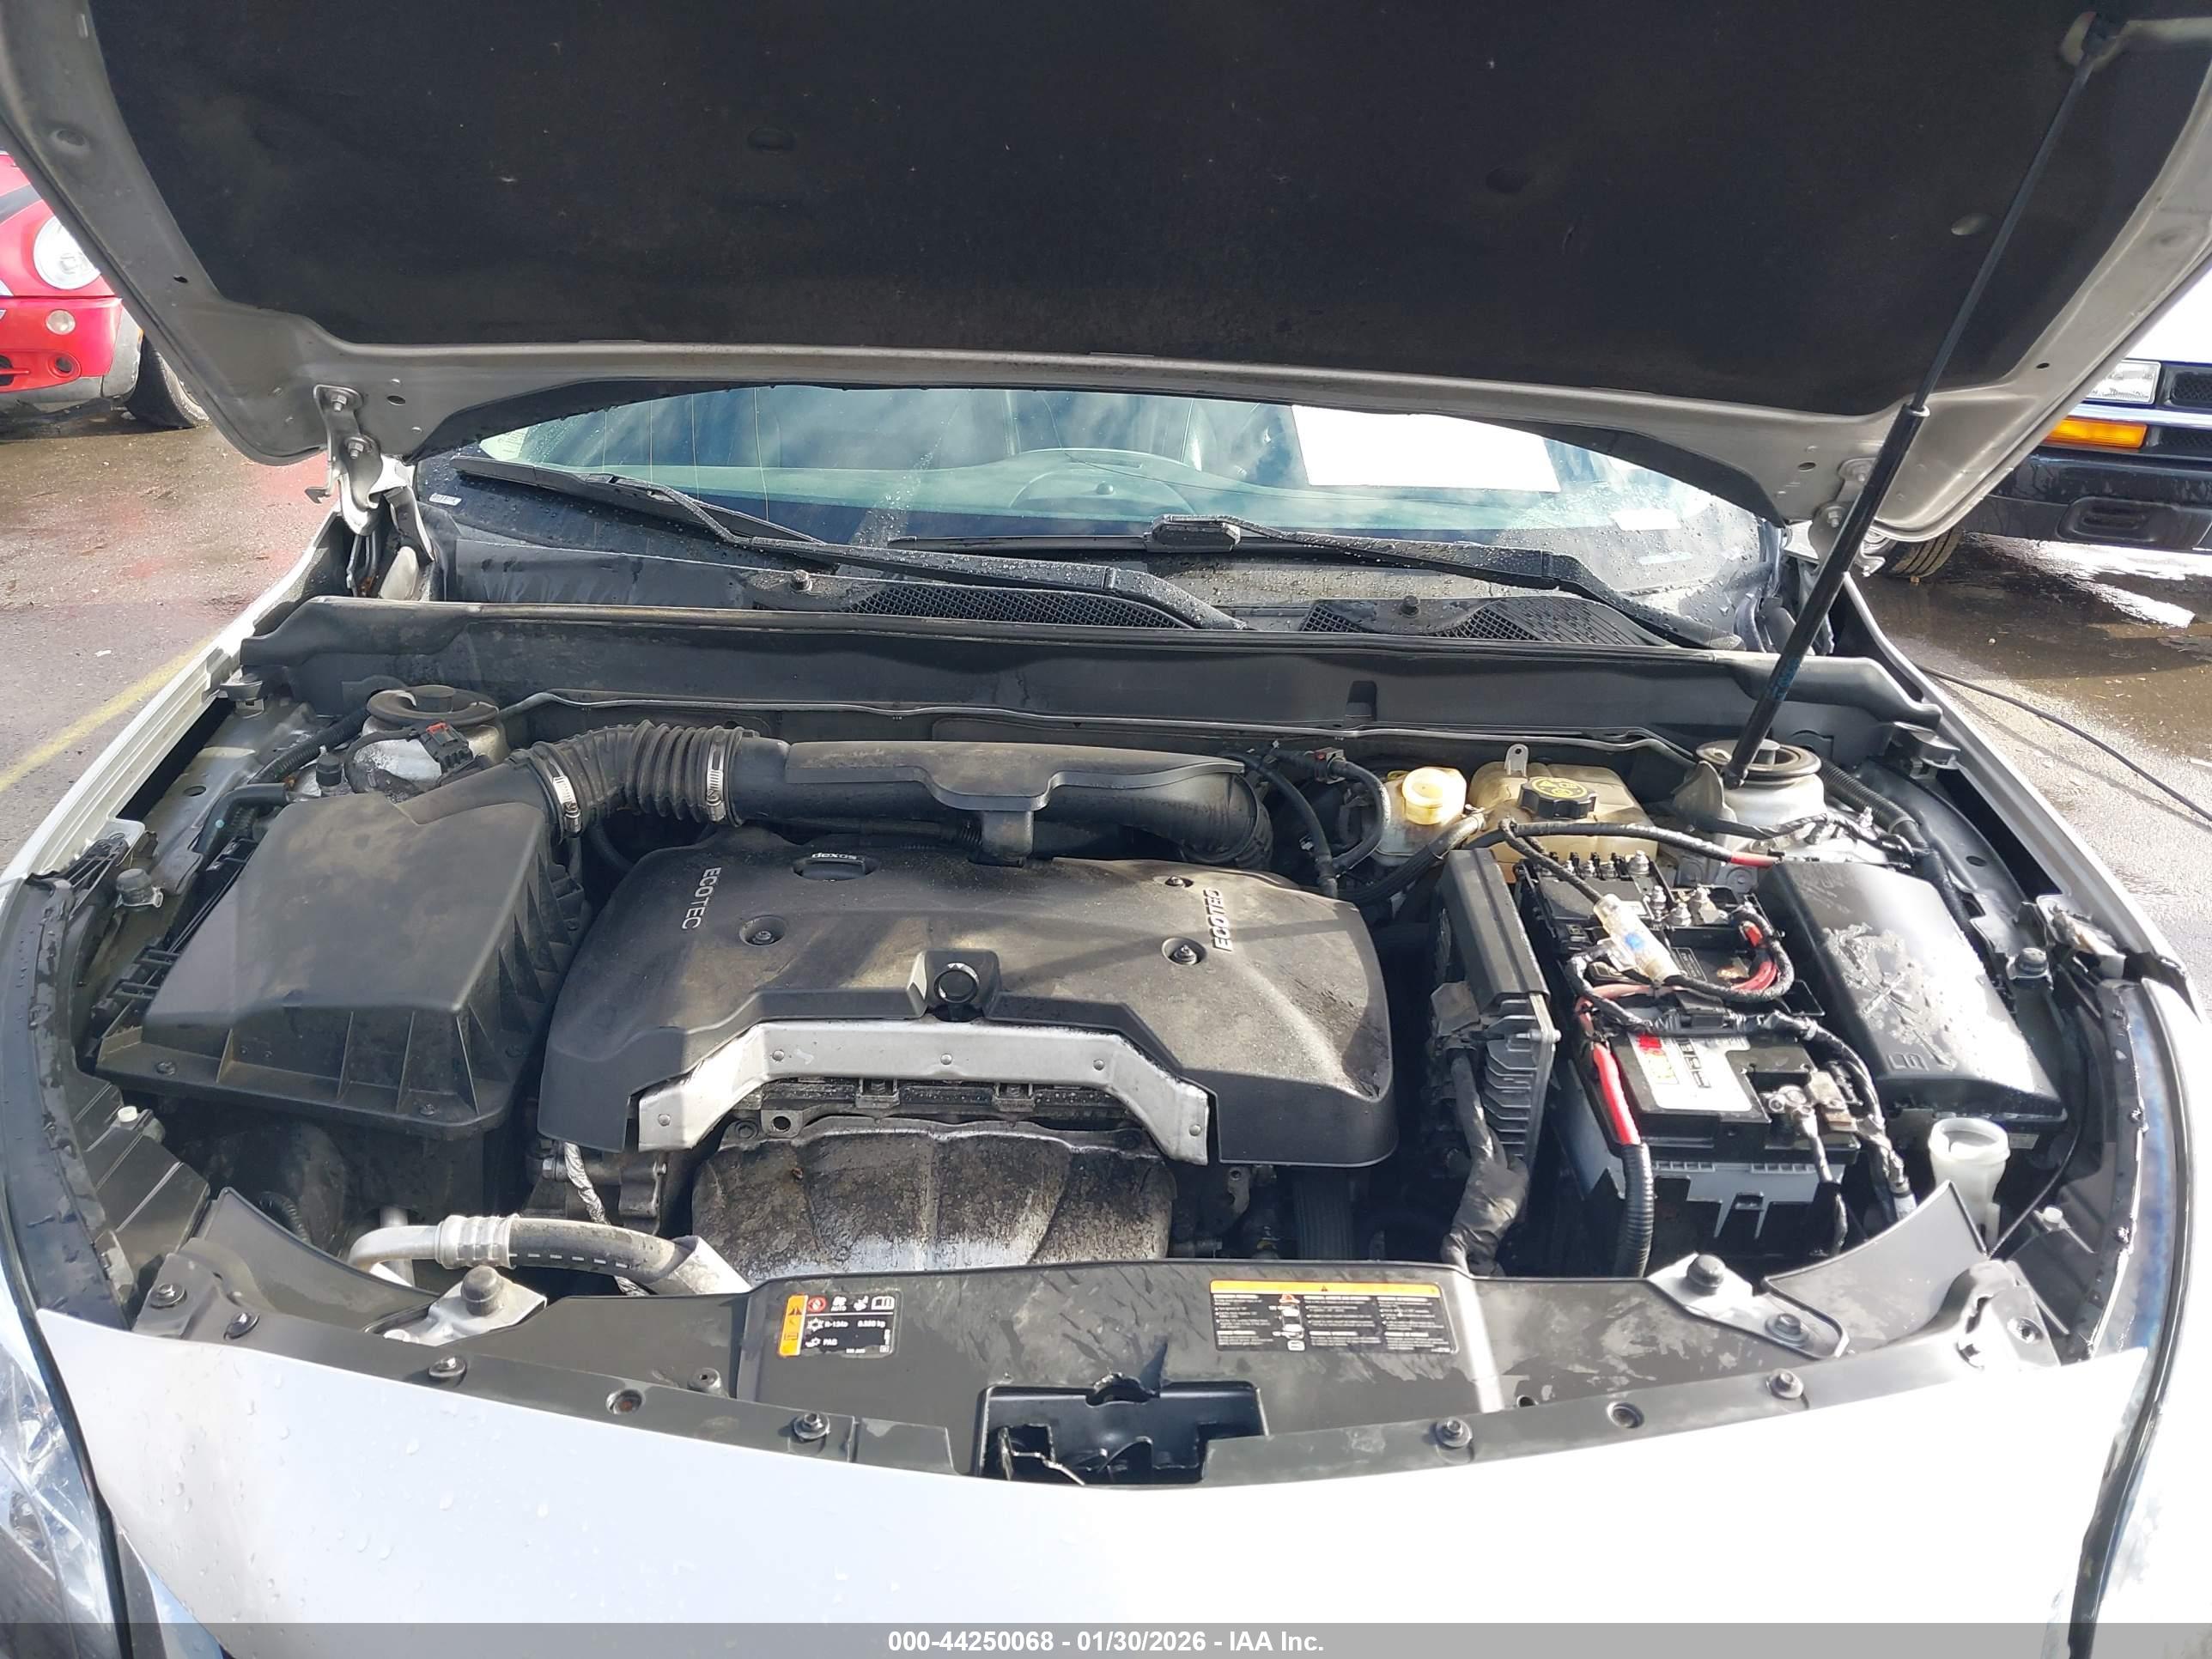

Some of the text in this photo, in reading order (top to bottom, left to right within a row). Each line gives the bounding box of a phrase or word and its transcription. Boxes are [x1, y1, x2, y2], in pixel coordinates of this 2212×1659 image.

[811, 852, 858, 860] dexos
[682, 866, 721, 930] ECOTEC
[1204, 888, 1232, 951] ECOTEC
